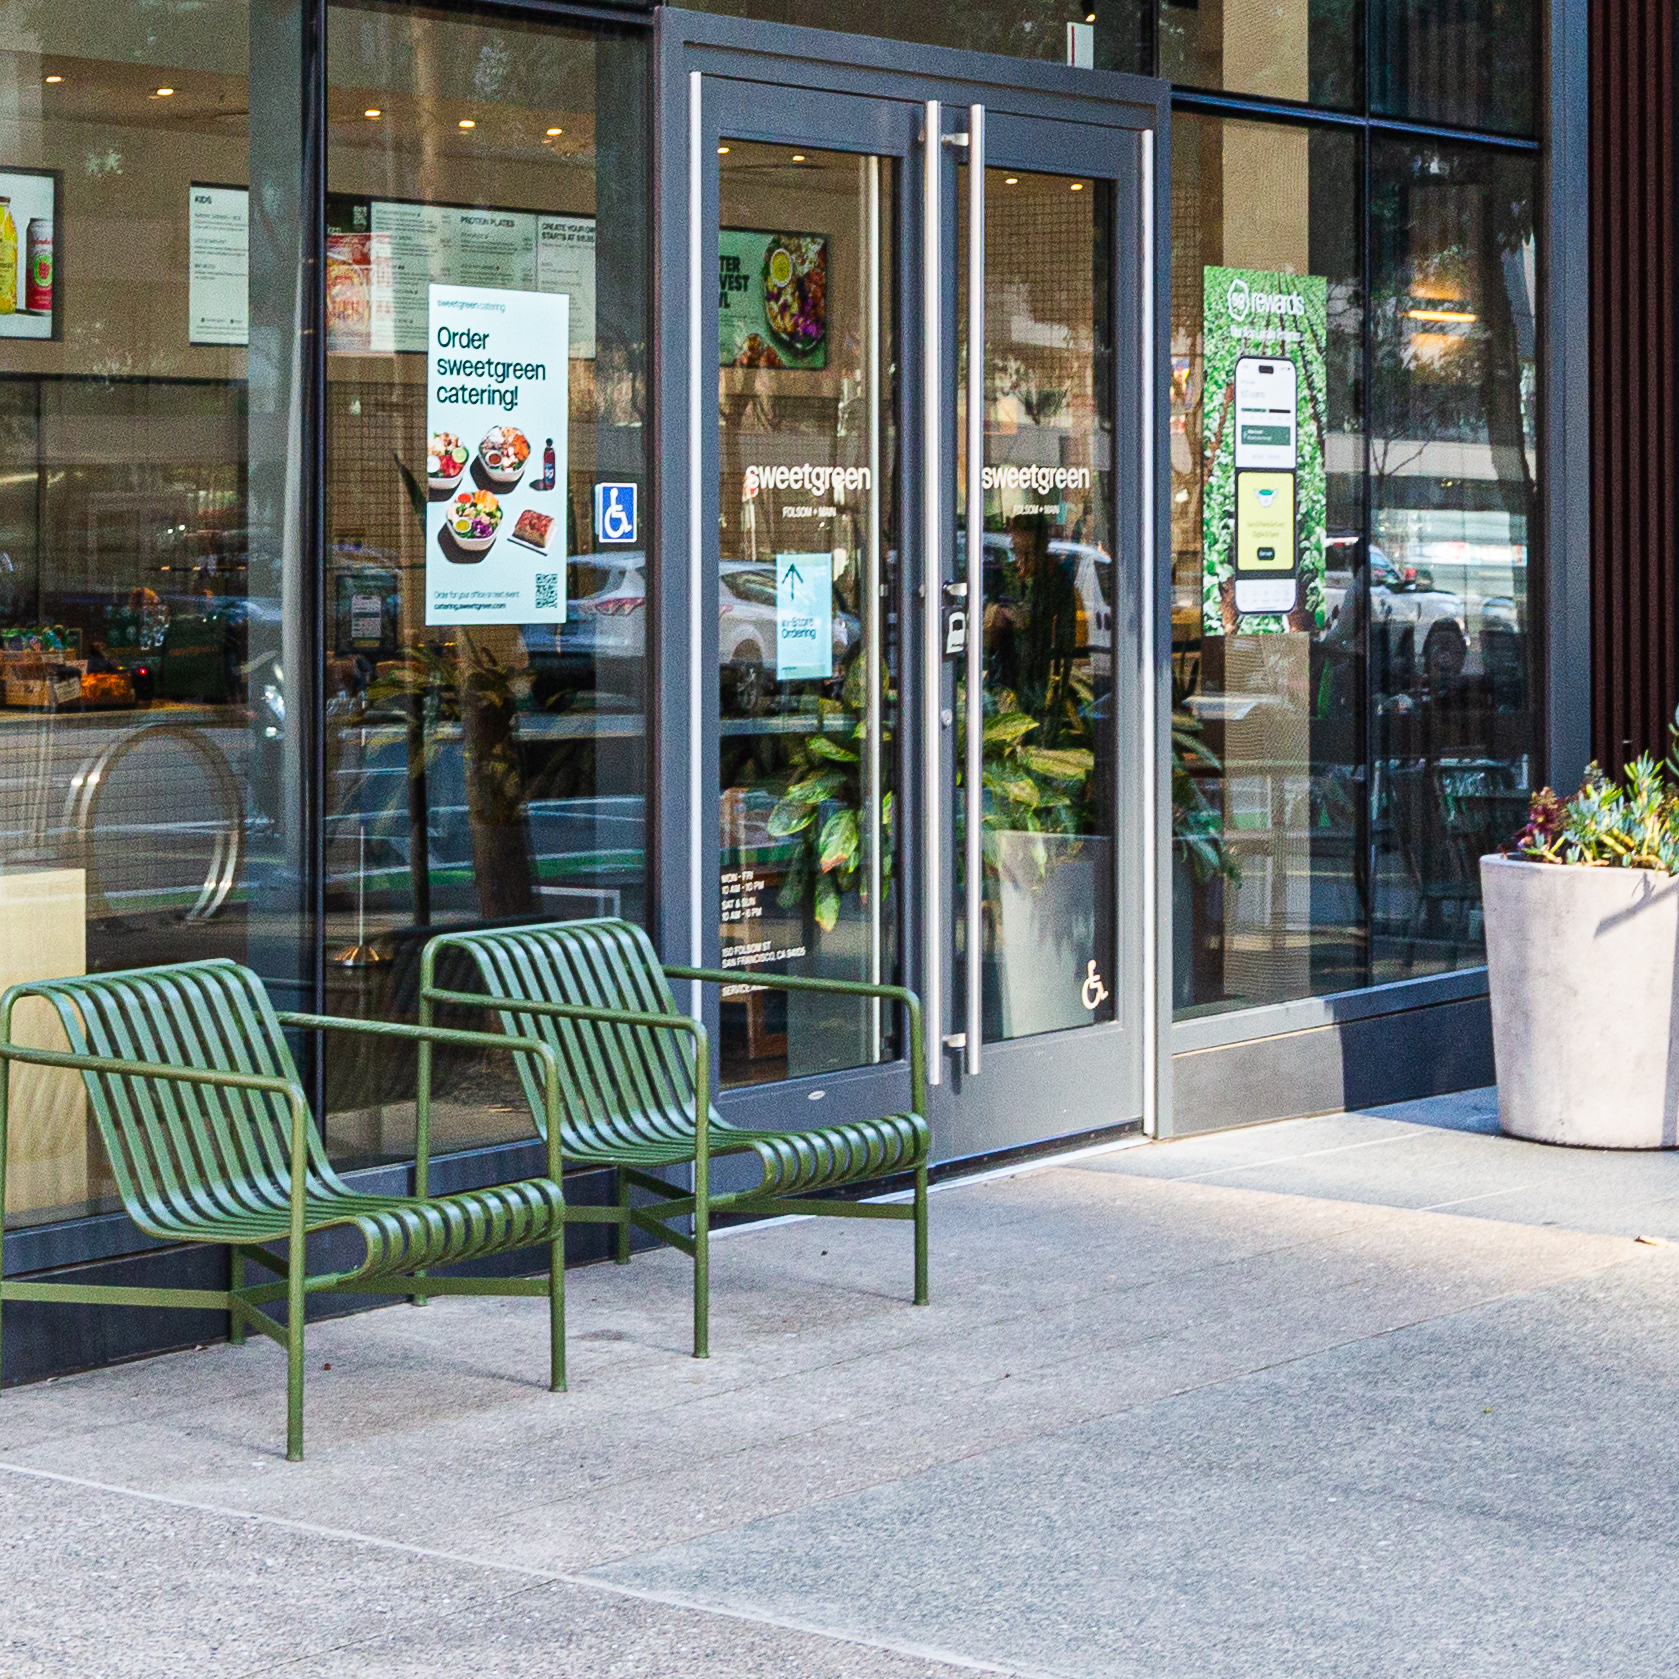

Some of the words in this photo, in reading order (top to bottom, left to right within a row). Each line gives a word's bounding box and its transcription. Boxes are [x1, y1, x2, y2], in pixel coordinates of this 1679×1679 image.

[194, 195, 212, 205] KIDS
[437, 300, 478, 311] sweetgreen
[1252, 291, 1305, 316] rewards
[437, 326, 490, 350] Order
[437, 358, 546, 384] sweetgreen
[437, 384, 518, 412] catering!
[745, 463, 871, 497] sweetgreen
[981, 464, 1090, 495] sweetgreen
[782, 505, 812, 518] FOLSOM
[818, 506, 837, 517] MAIN
[782, 629, 817, 640] Ordering
[734, 942, 762, 955] FOLSOM
[722, 958, 737, 969] SAN
